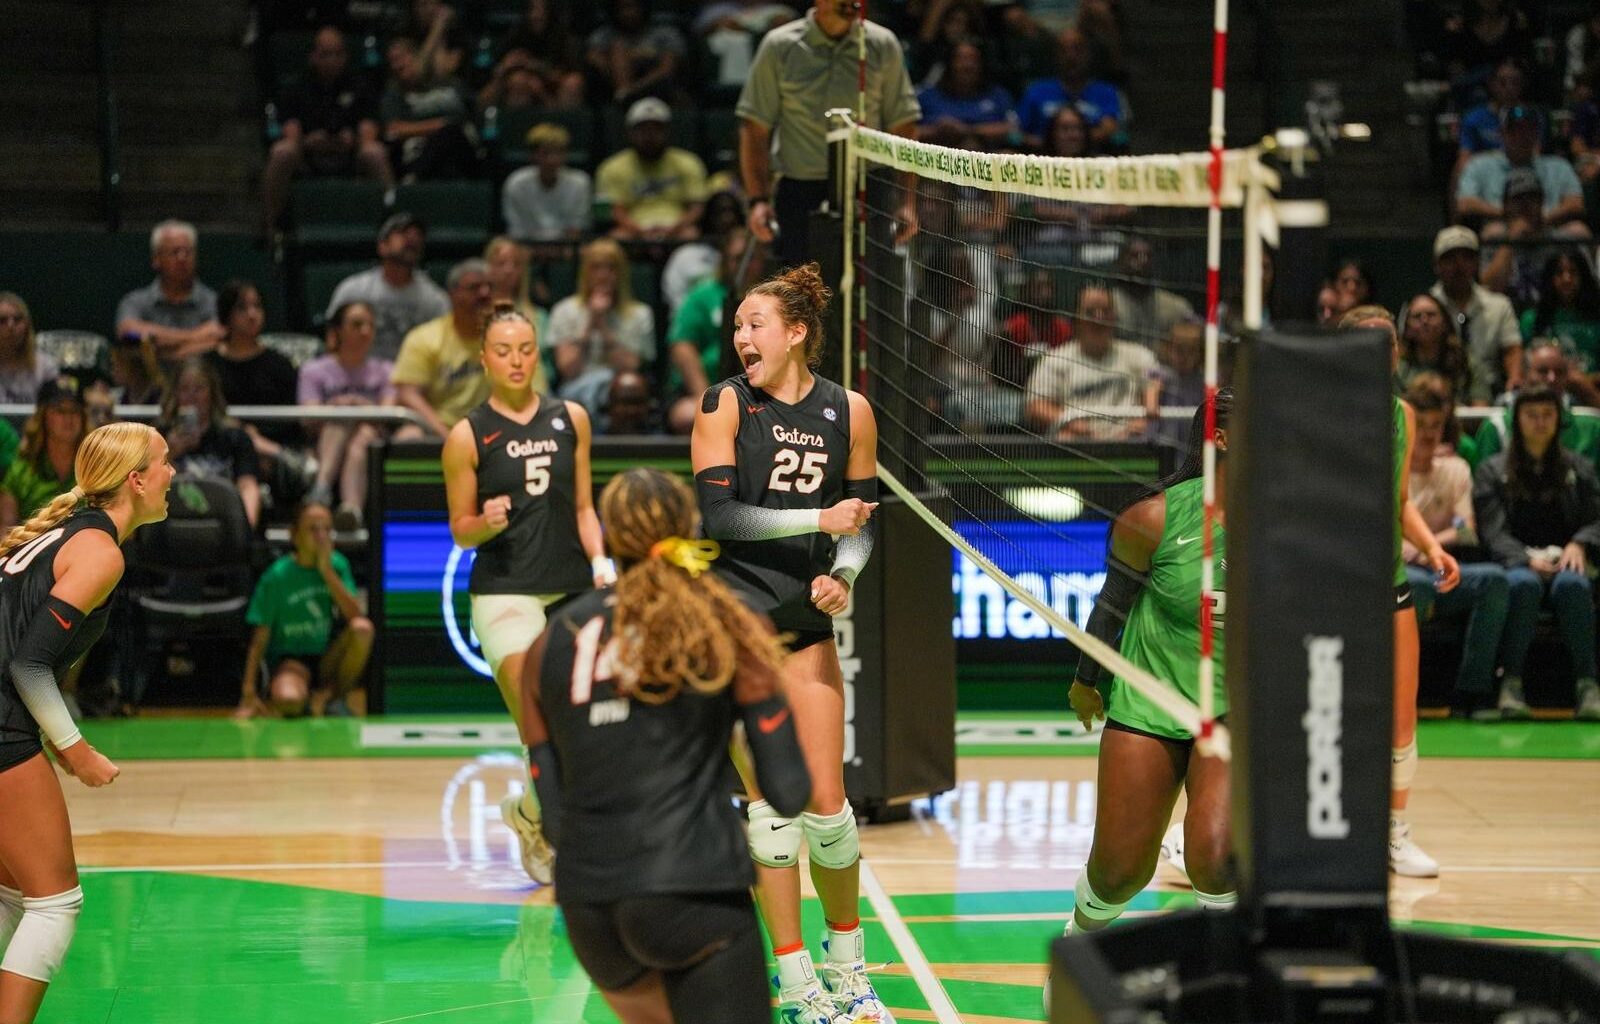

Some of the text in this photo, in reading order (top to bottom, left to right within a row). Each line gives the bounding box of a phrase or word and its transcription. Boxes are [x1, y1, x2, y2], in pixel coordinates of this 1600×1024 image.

[506, 439, 558, 458] Gators
[772, 424, 824, 447] Gators
[525, 455, 551, 496] 5
[768, 448, 828, 494] 25
[0, 528, 65, 575] 0
